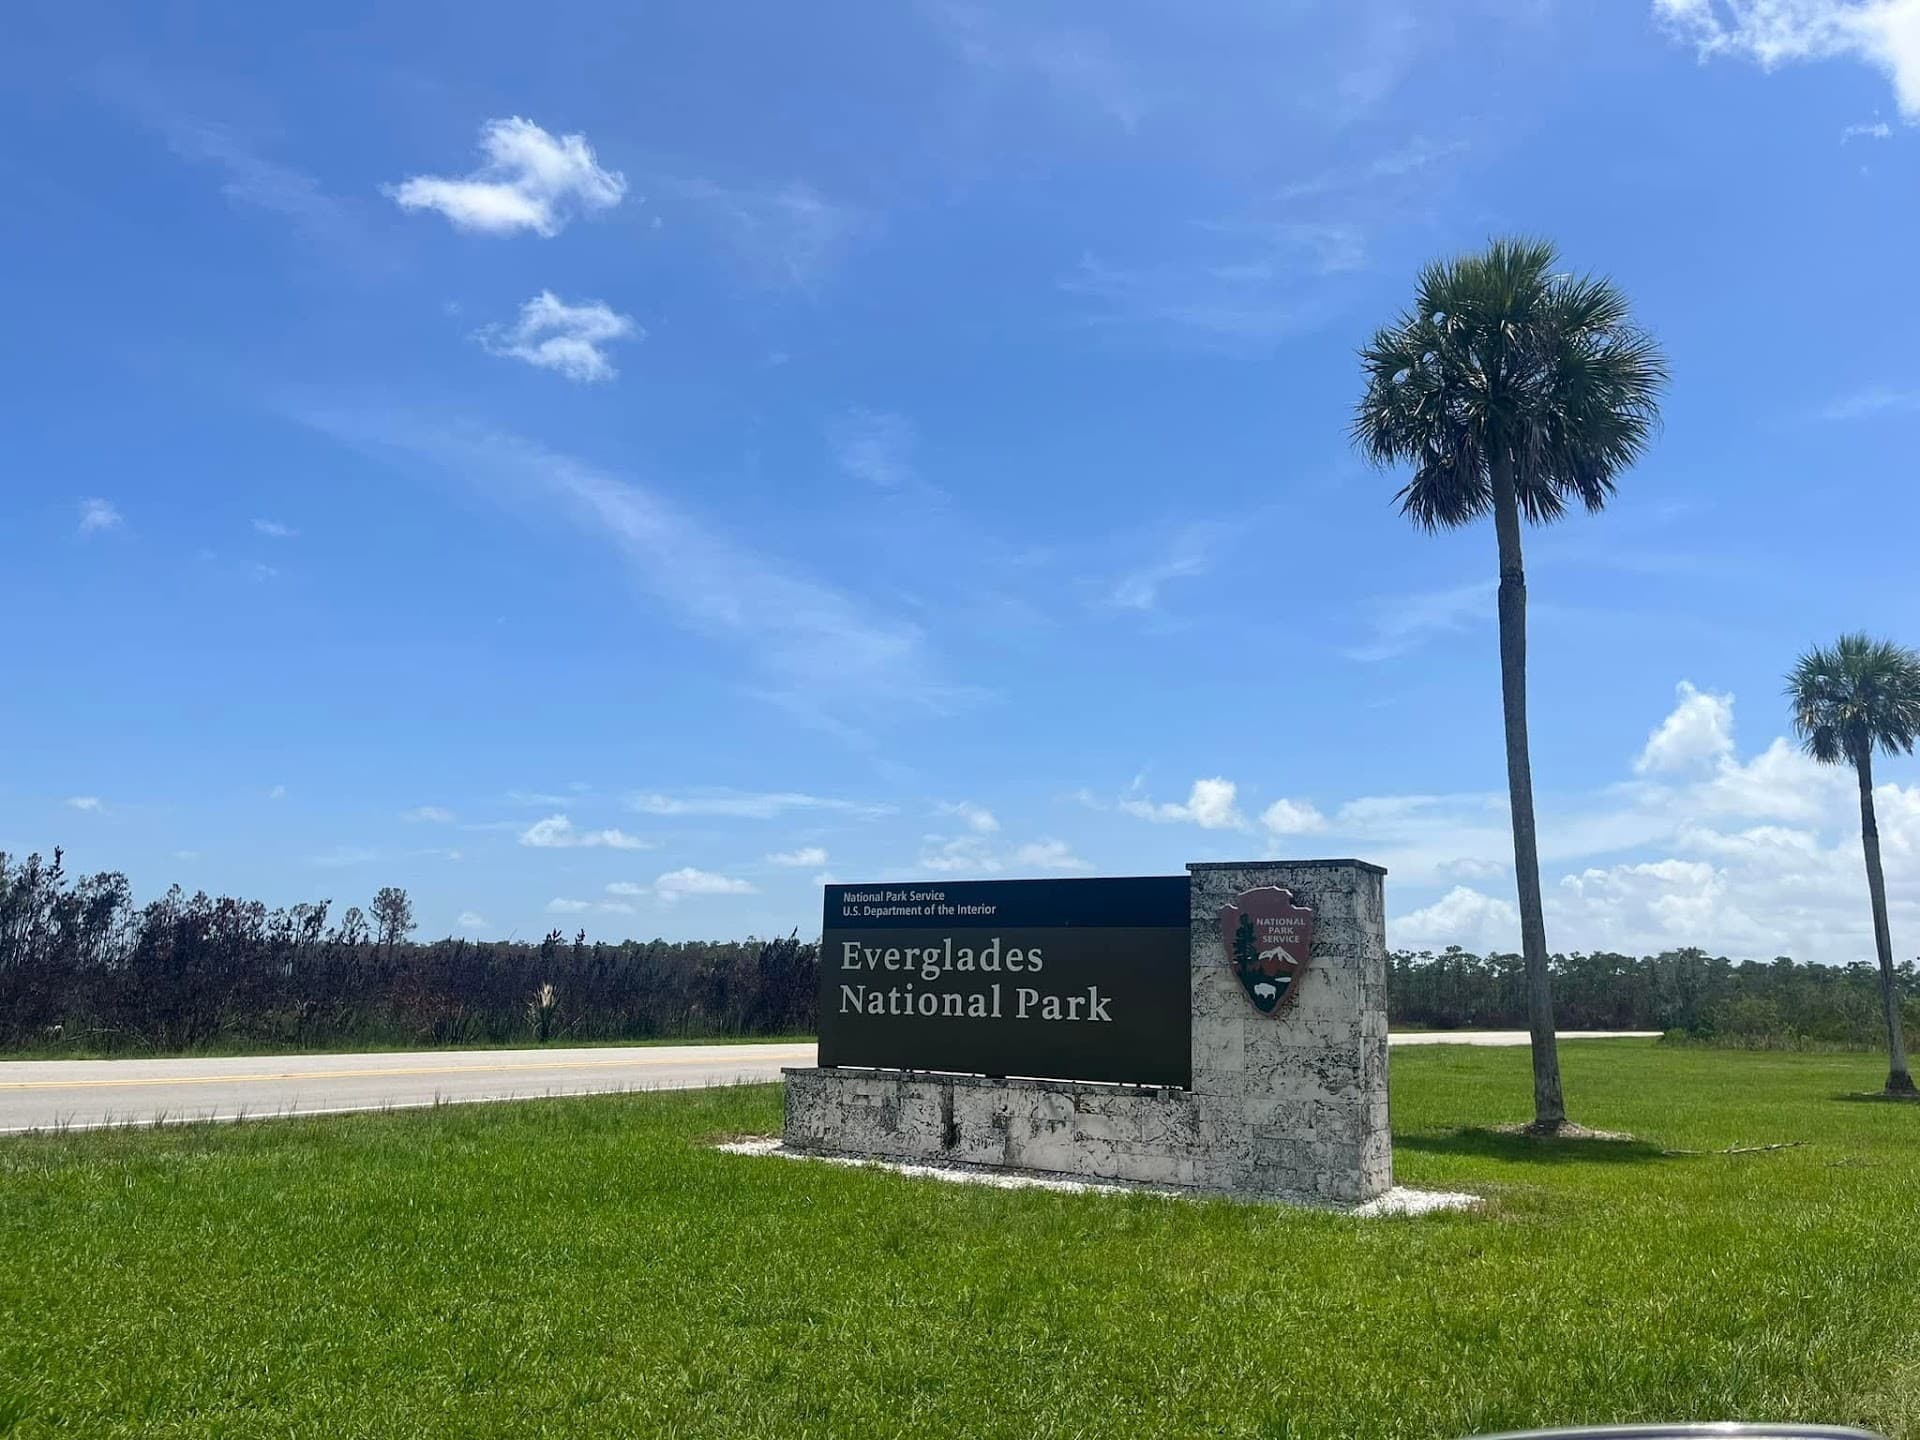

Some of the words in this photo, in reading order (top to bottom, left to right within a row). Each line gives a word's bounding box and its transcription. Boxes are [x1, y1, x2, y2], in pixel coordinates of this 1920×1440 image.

[843, 890, 883, 902] National
[886, 890, 907, 901] Park
[909, 889, 945, 901] Service
[842, 905, 861, 916] U.S.
[863, 905, 922, 918] Department
[924, 904, 935, 915] of
[937, 904, 954, 915] the
[957, 903, 997, 915] Interior
[1256, 917, 1306, 926] NATIONAL
[1268, 926, 1294, 935] PARK
[1262, 935, 1300, 944] SERVICE
[840, 937, 1043, 981] Everglades
[839, 983, 1002, 1018] National
[1015, 985, 1113, 1022] Park
